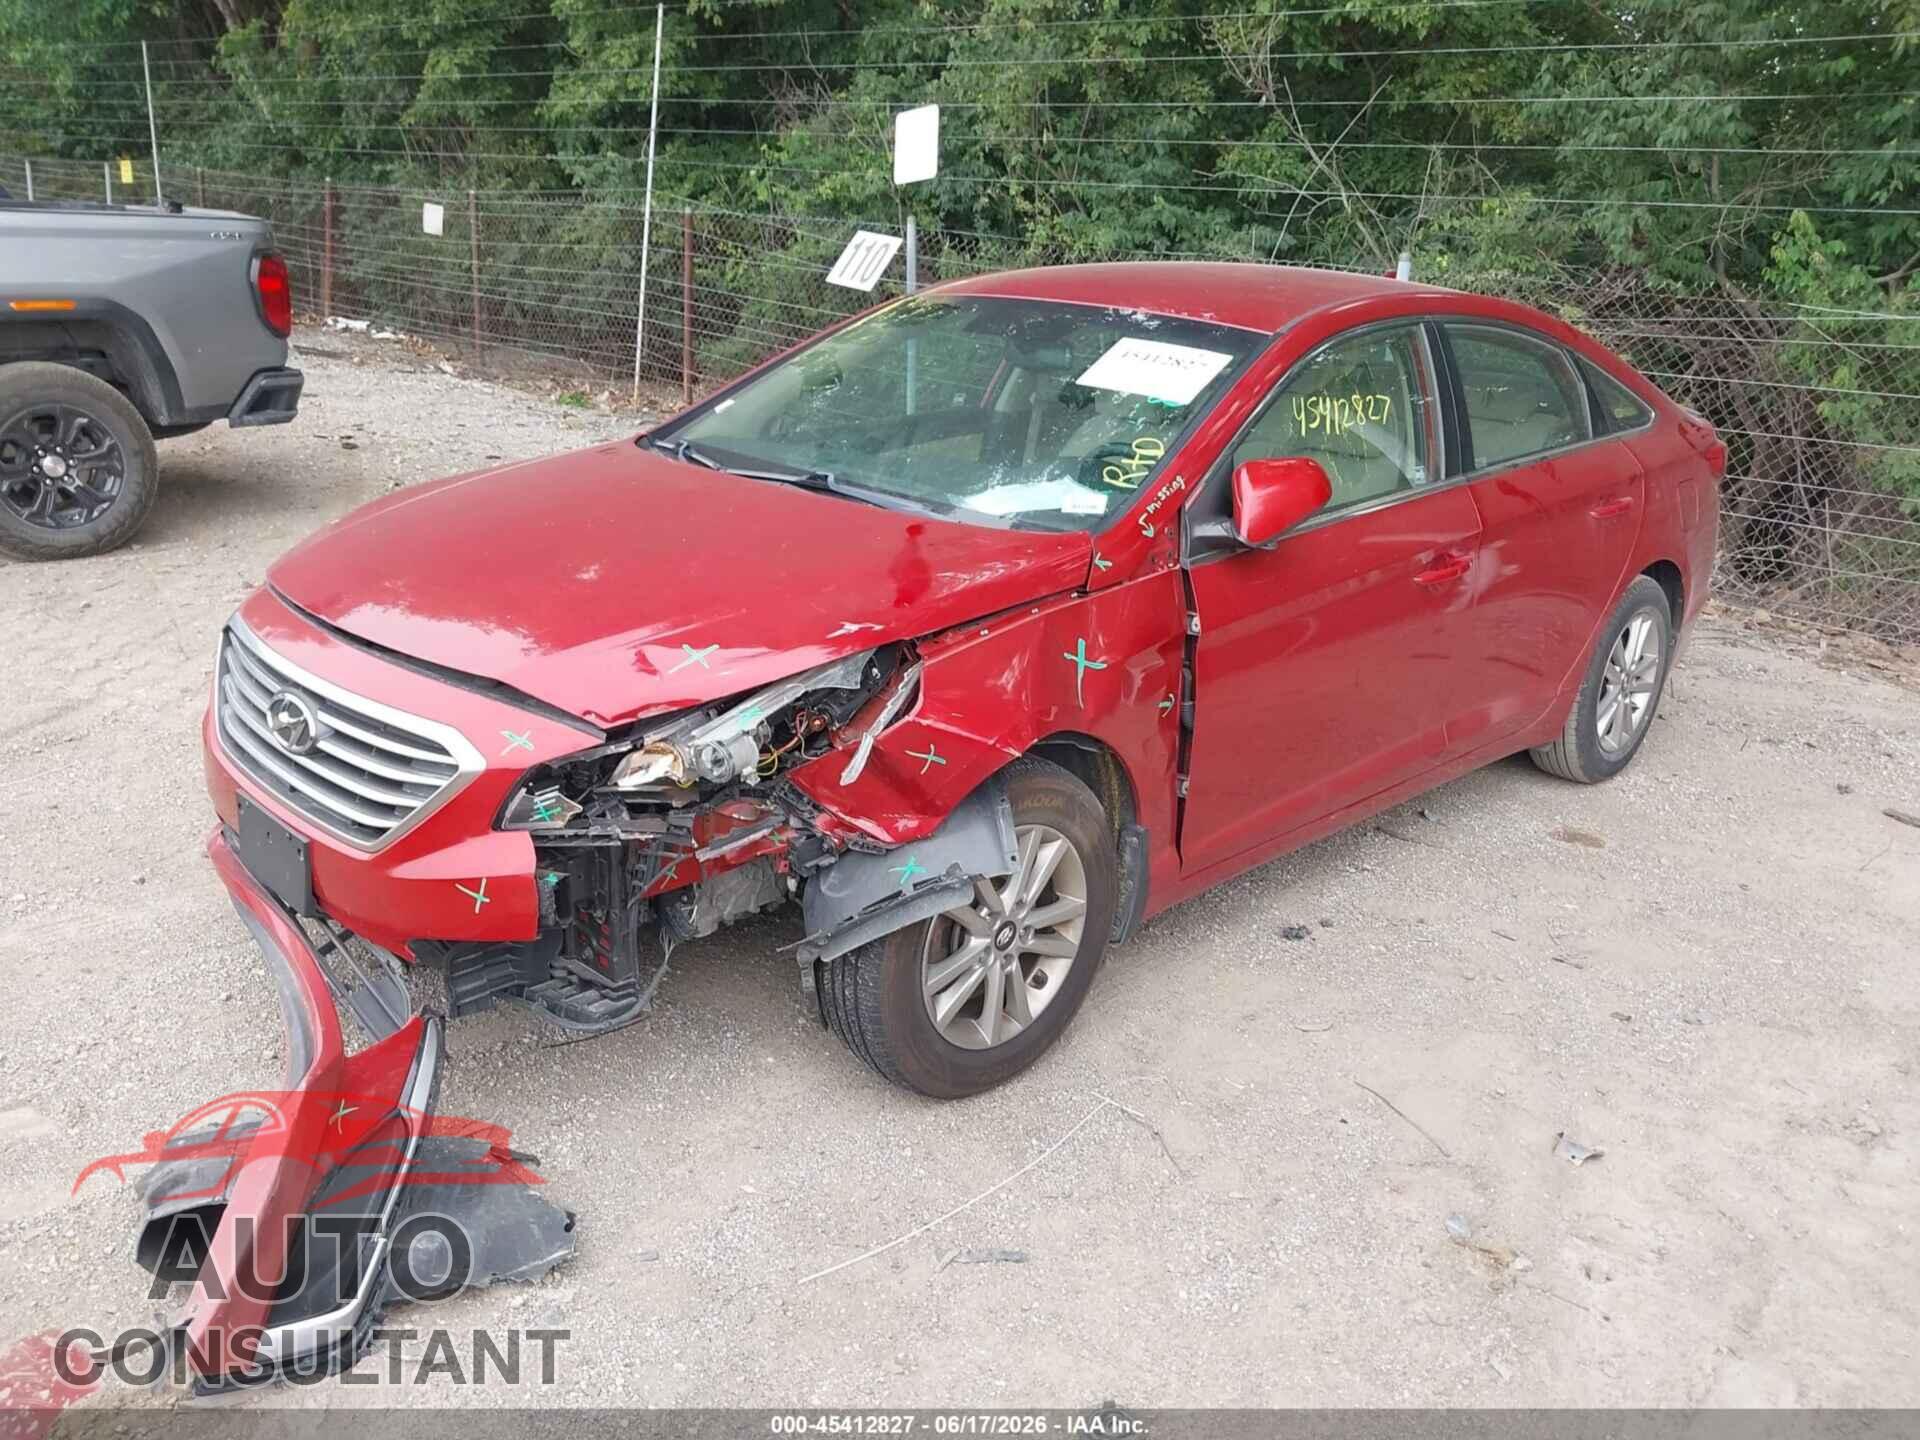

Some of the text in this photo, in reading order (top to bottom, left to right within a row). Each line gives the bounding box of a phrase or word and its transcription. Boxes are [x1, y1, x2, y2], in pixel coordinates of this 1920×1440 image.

[838, 238, 890, 283] 110
[1292, 394, 1391, 438] 45412827
[1145, 474, 1186, 515] missing
